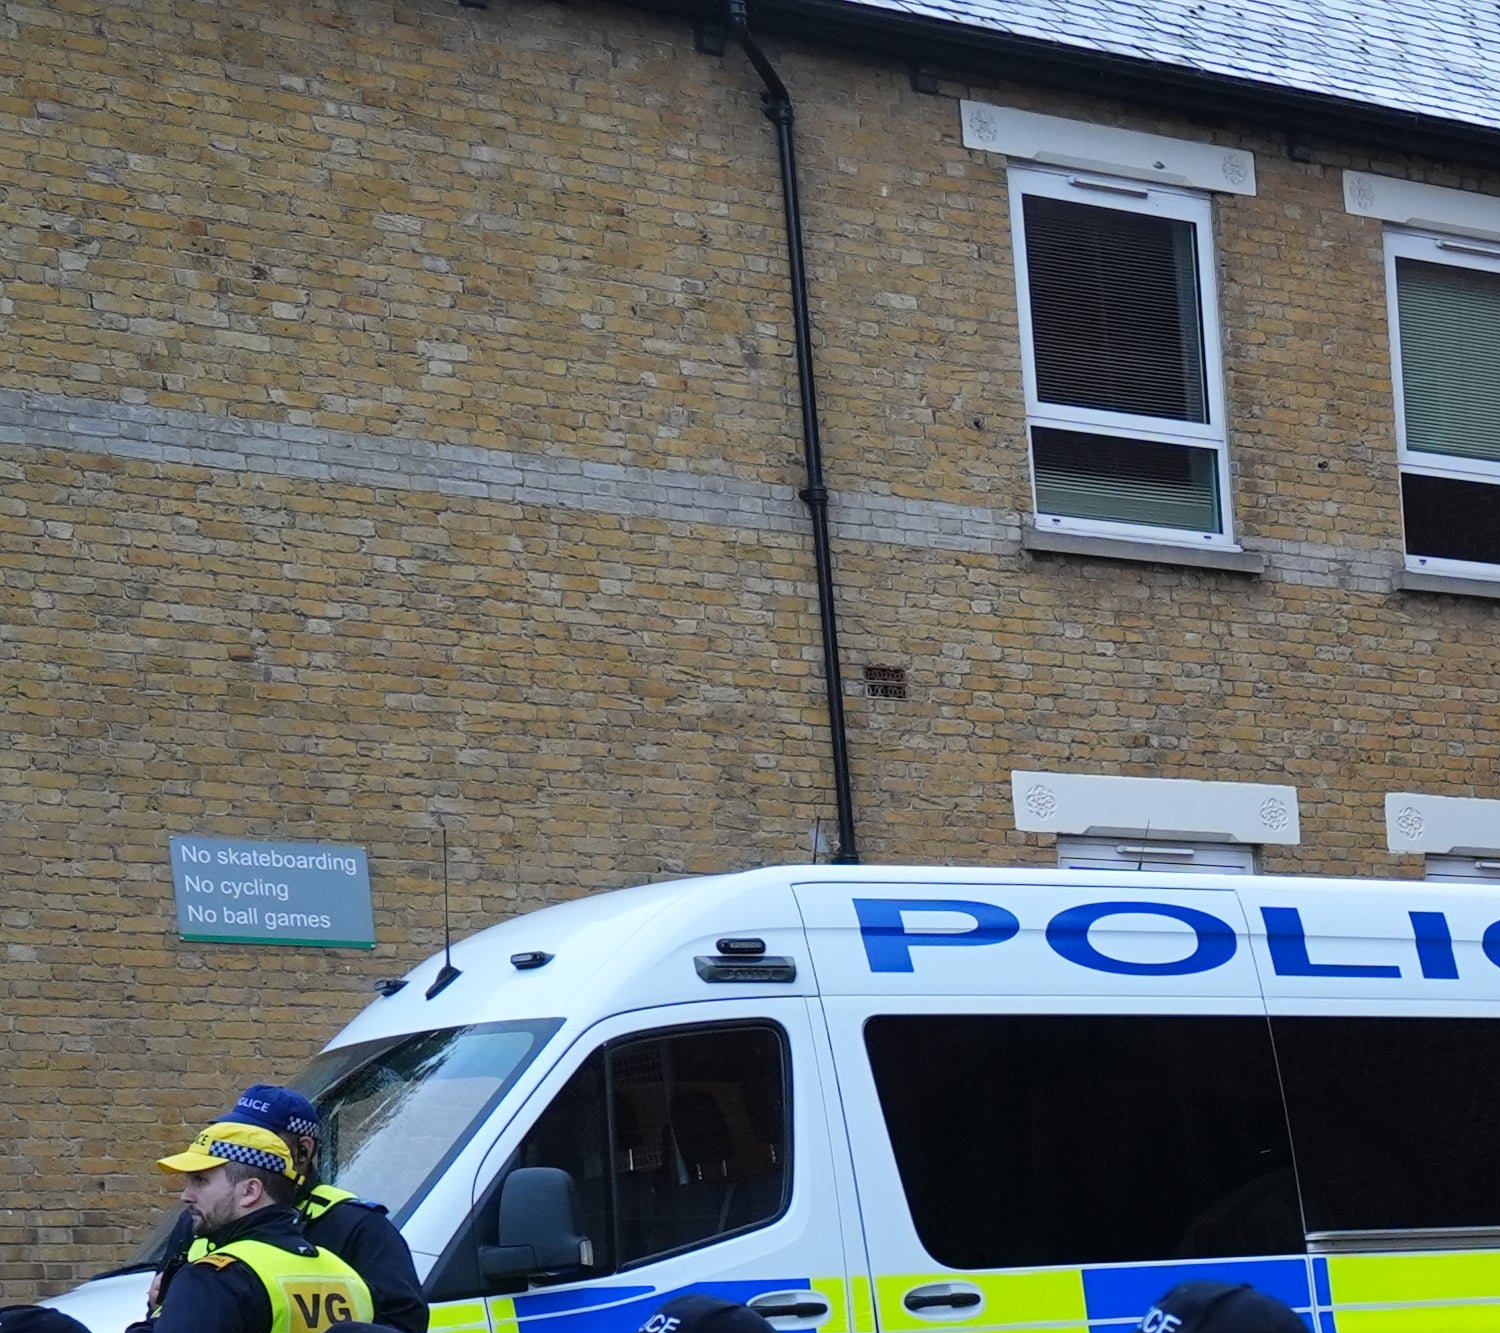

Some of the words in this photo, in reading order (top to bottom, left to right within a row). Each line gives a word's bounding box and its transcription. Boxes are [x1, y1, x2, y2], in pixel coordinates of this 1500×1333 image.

[181, 845, 211, 864] No
[217, 849, 357, 876] skateboarding
[184, 875, 214, 894] No
[220, 879, 289, 901] cycling
[187, 905, 217, 924] No
[223, 906, 258, 926] ball
[265, 912, 331, 931] games
[292, 1293, 352, 1329] VG
